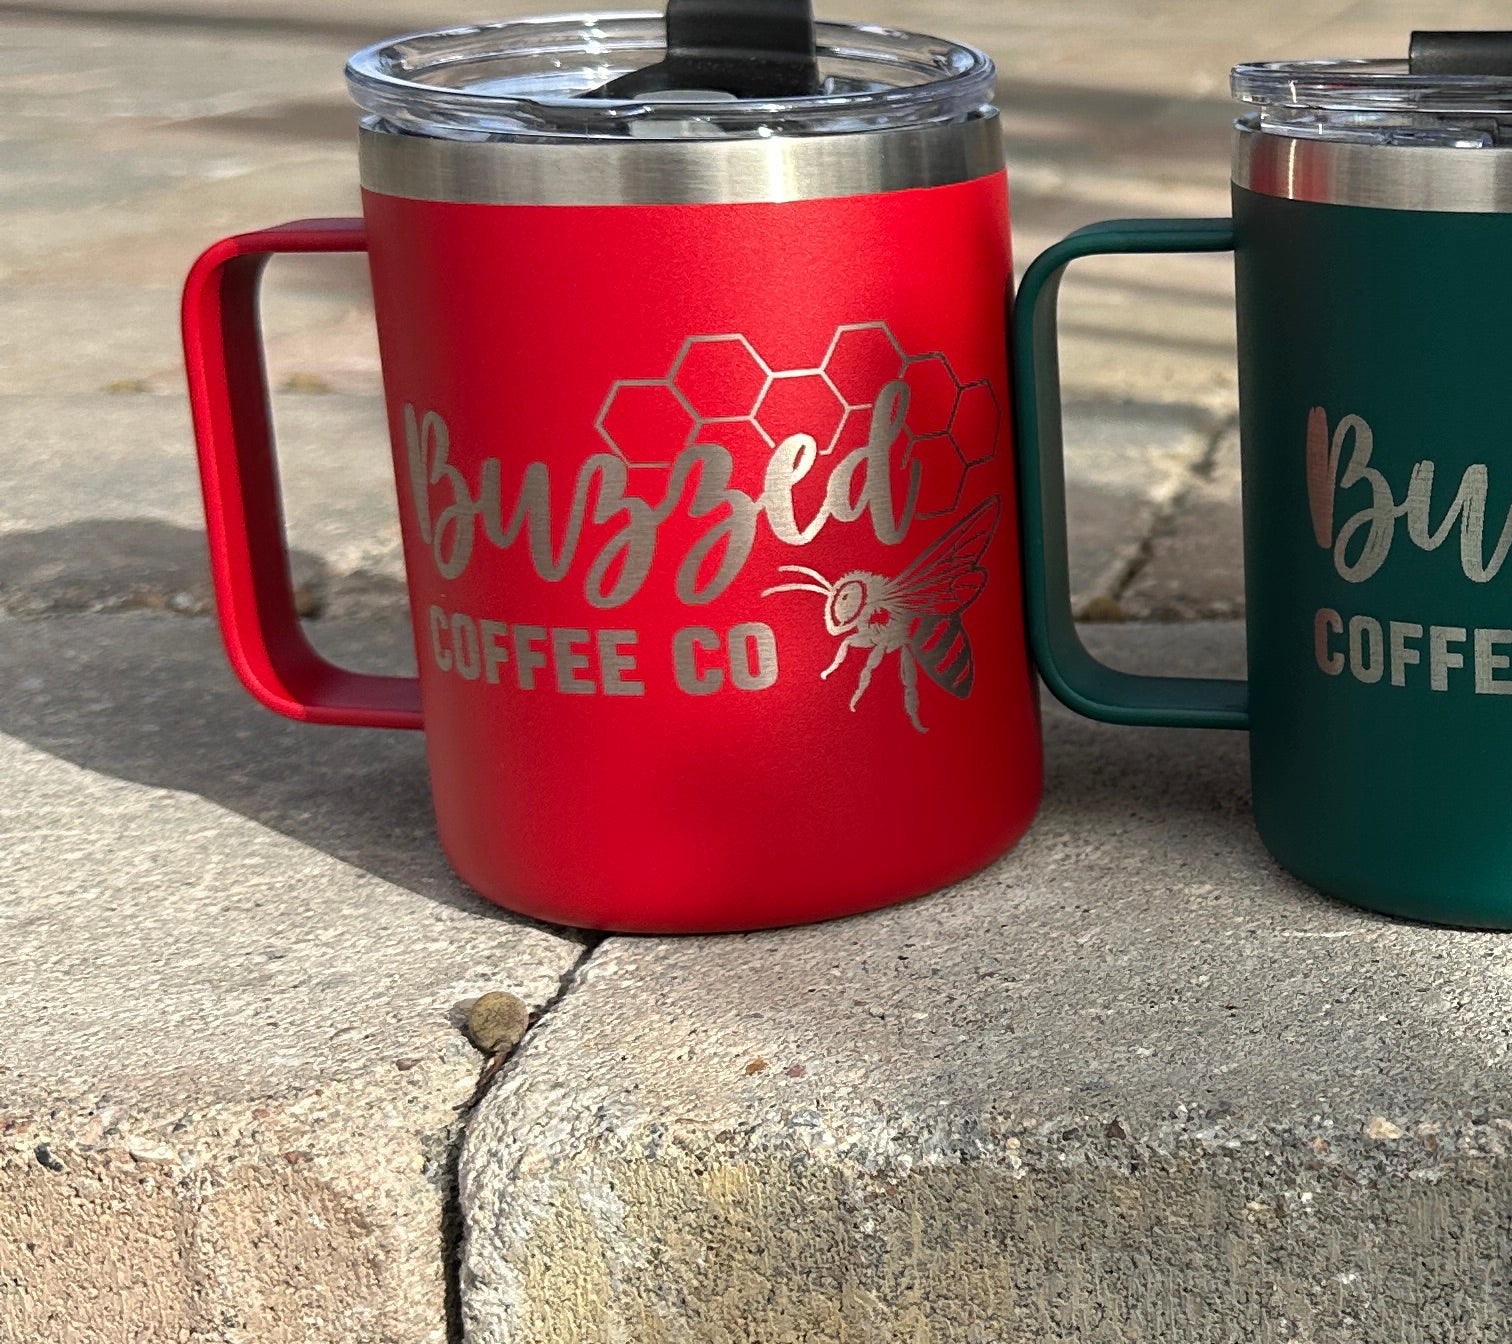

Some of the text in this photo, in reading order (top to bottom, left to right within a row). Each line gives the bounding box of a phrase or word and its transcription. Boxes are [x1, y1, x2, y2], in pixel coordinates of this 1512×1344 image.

[405, 381, 920, 608] Buzzed
[429, 605, 779, 697] COFFEE CO
